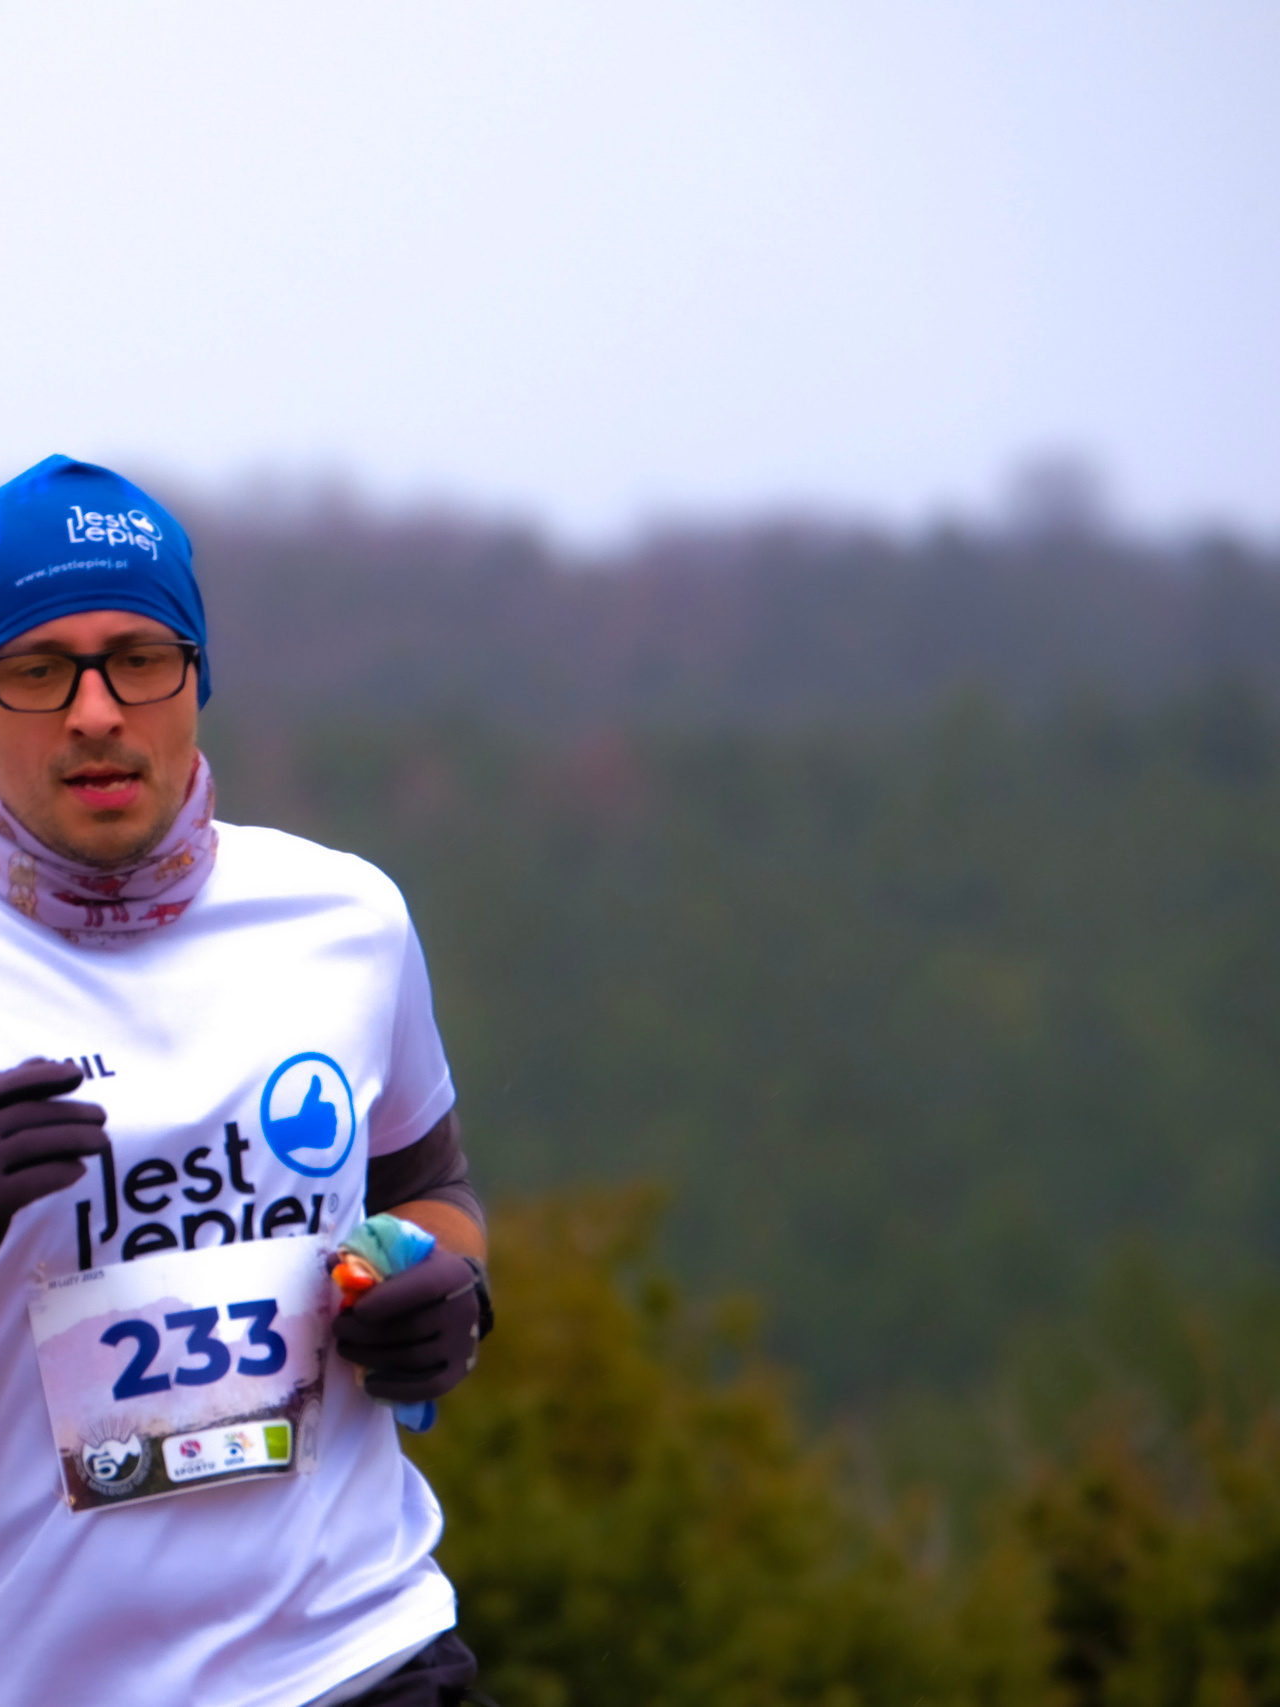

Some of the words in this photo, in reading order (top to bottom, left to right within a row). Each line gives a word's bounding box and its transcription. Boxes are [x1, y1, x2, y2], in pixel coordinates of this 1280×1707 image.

[67, 518, 158, 561] Lepiej
[70, 505, 131, 530] Jest
[99, 1121, 255, 1243] Jest
[99, 1299, 287, 1401] 233
